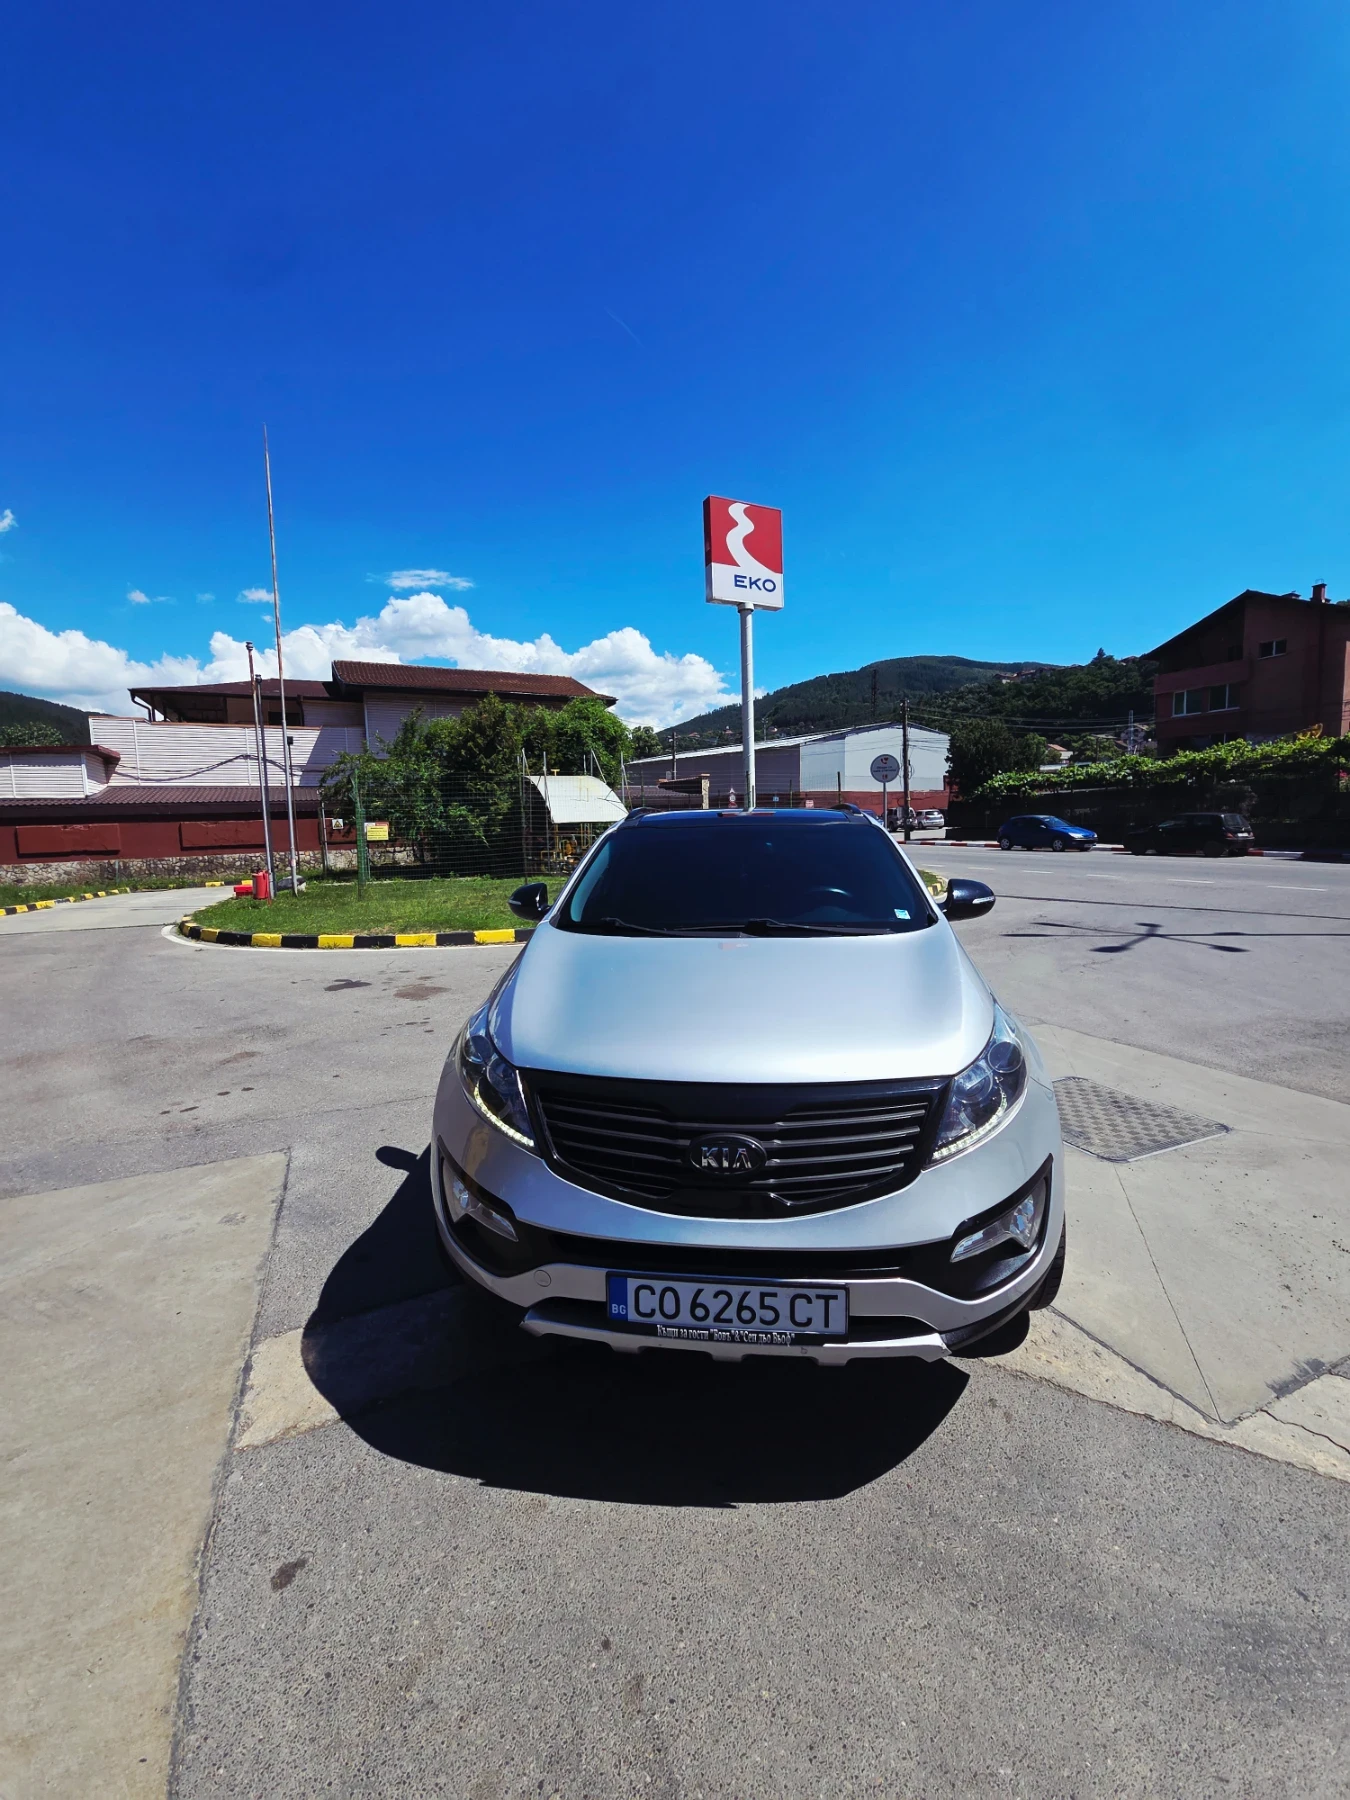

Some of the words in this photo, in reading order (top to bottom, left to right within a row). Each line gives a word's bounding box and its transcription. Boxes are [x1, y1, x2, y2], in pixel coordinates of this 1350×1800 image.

[734, 574, 776, 593] EKO
[701, 1146, 752, 1169] KIA
[611, 1303, 627, 1315] BG
[633, 1284, 681, 1320] CO
[689, 1288, 780, 1326] 6265
[789, 1293, 839, 1329] CT
[679, 1328, 688, 1338] за
[688, 1329, 709, 1340] гости
